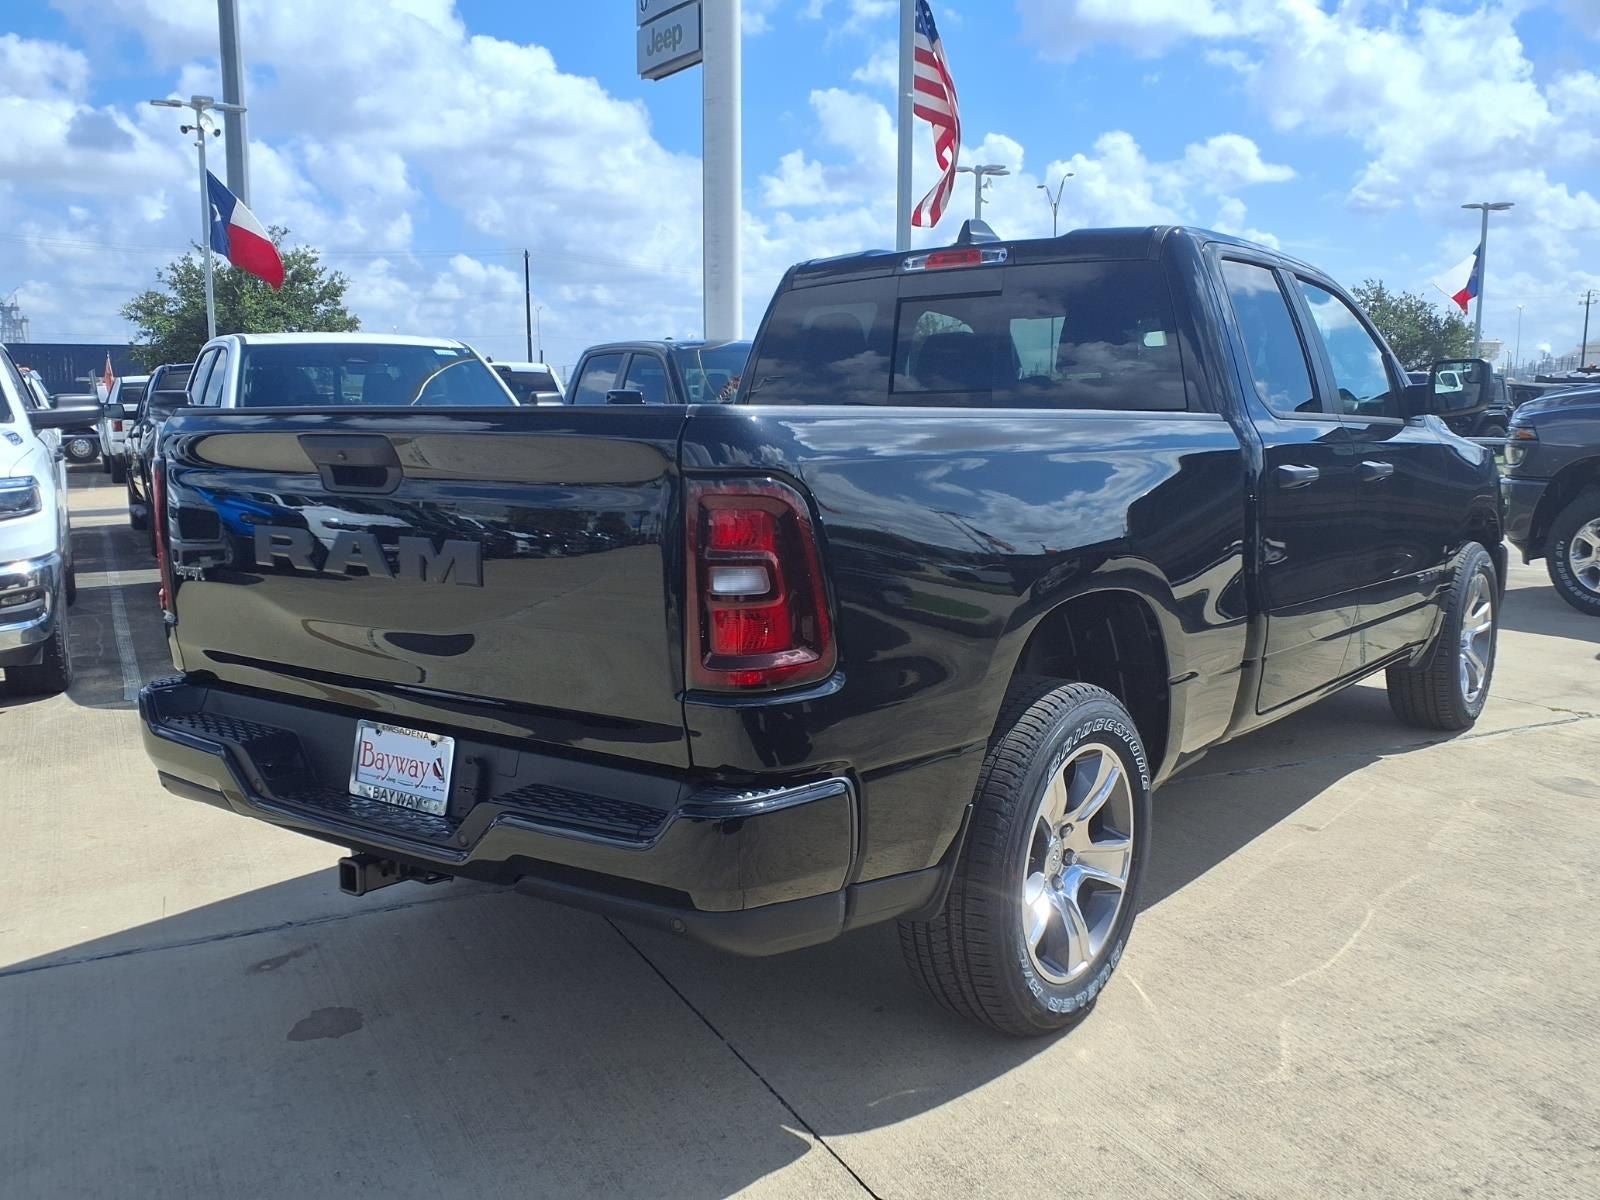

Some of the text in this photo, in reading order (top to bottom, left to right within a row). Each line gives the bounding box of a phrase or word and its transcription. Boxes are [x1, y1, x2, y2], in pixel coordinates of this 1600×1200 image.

[646, 24, 682, 56] Jeep
[254, 525, 484, 587] RAM
[382, 725, 430, 740] PASADENA
[360, 741, 430, 789] Bayway
[1047, 718, 1150, 790] BRIDGESTONE
[372, 786, 421, 808] BAYWAY
